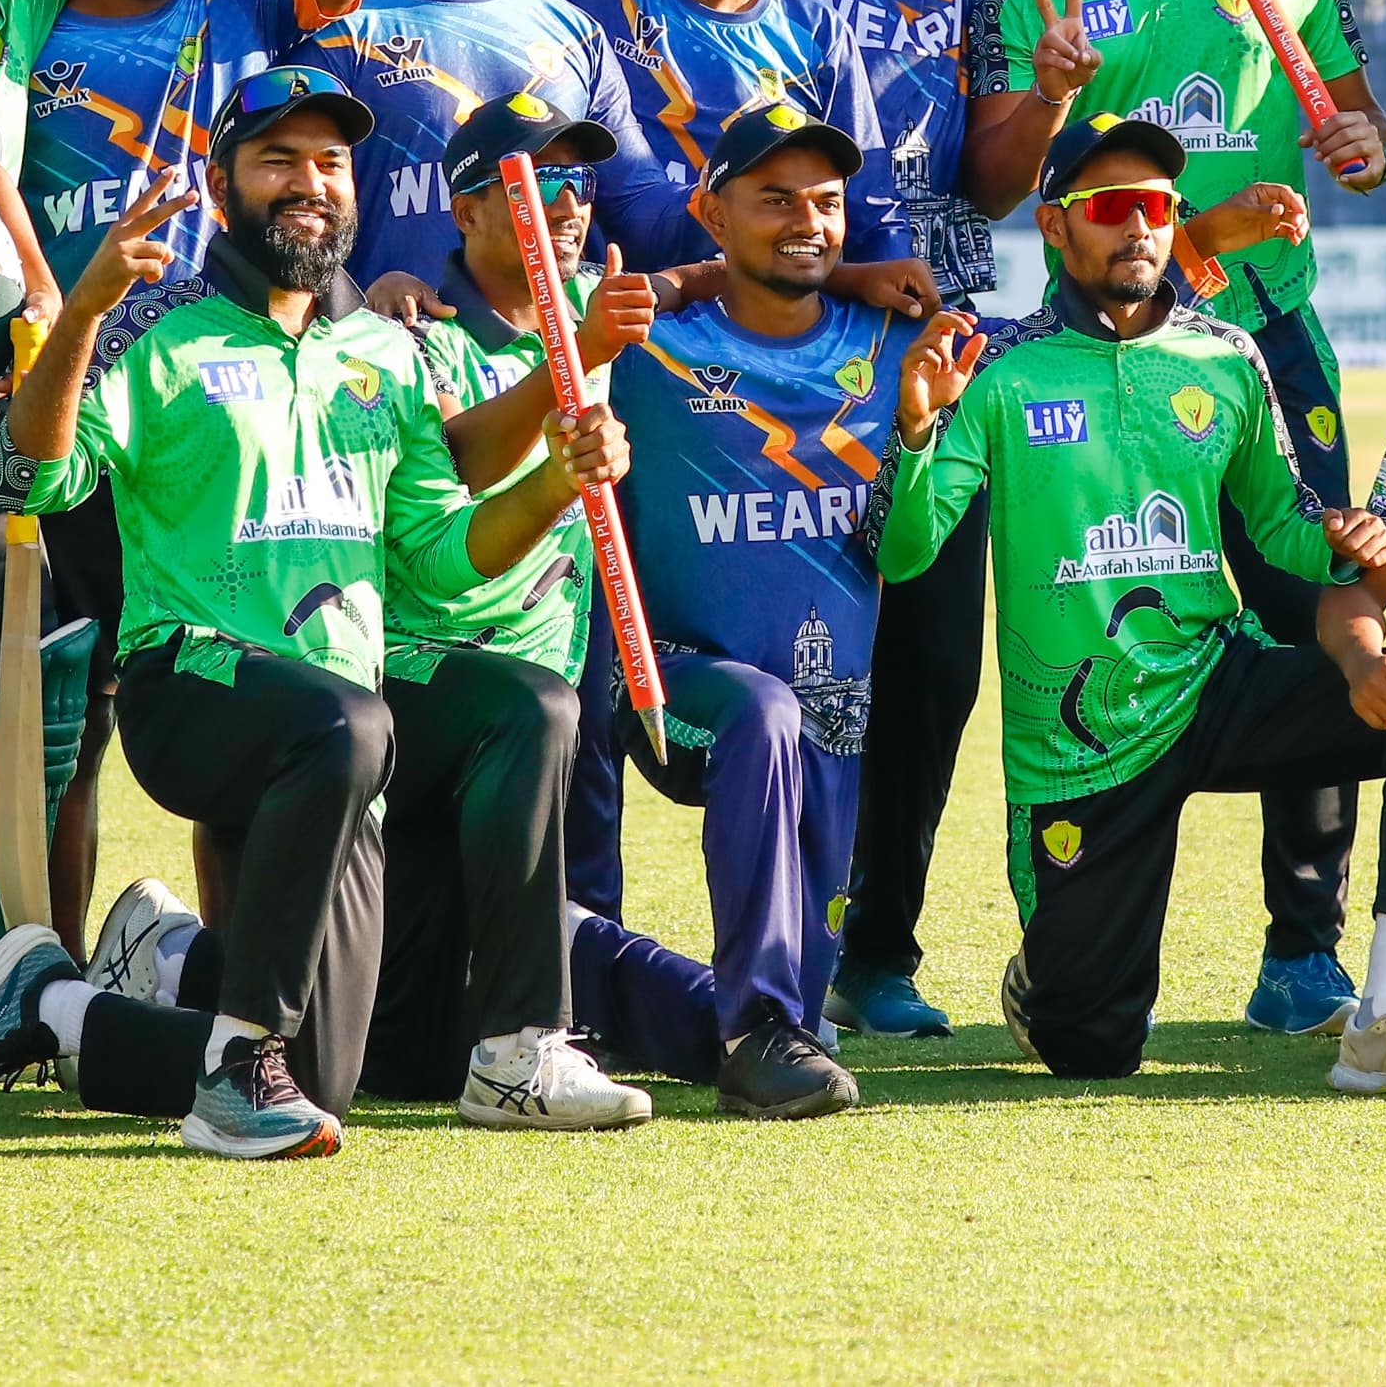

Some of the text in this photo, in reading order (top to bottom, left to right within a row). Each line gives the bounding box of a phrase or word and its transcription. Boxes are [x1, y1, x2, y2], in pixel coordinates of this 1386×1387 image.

[615, 40, 662, 69] WEARIX
[1277, 31, 1299, 64] Islami
[1293, 59, 1315, 90] Bank
[379, 67, 436, 87] WEARIX
[1216, 133, 1255, 149] Bank
[516, 204, 580, 417] Al-Arafah Islami Bank PLC. aib
[199, 366, 258, 400] Lily
[691, 399, 747, 412] WEARIX
[1026, 407, 1085, 442] Lily
[238, 519, 316, 540] Al-Arafah
[591, 504, 610, 539] PLC.
[1089, 517, 1138, 551] aib
[600, 540, 621, 577] Bank
[1060, 558, 1133, 580] Al-Arafah
[1180, 552, 1216, 571] Bank
[612, 579, 632, 621] Islami
[621, 622, 650, 689] Al-Arafah
